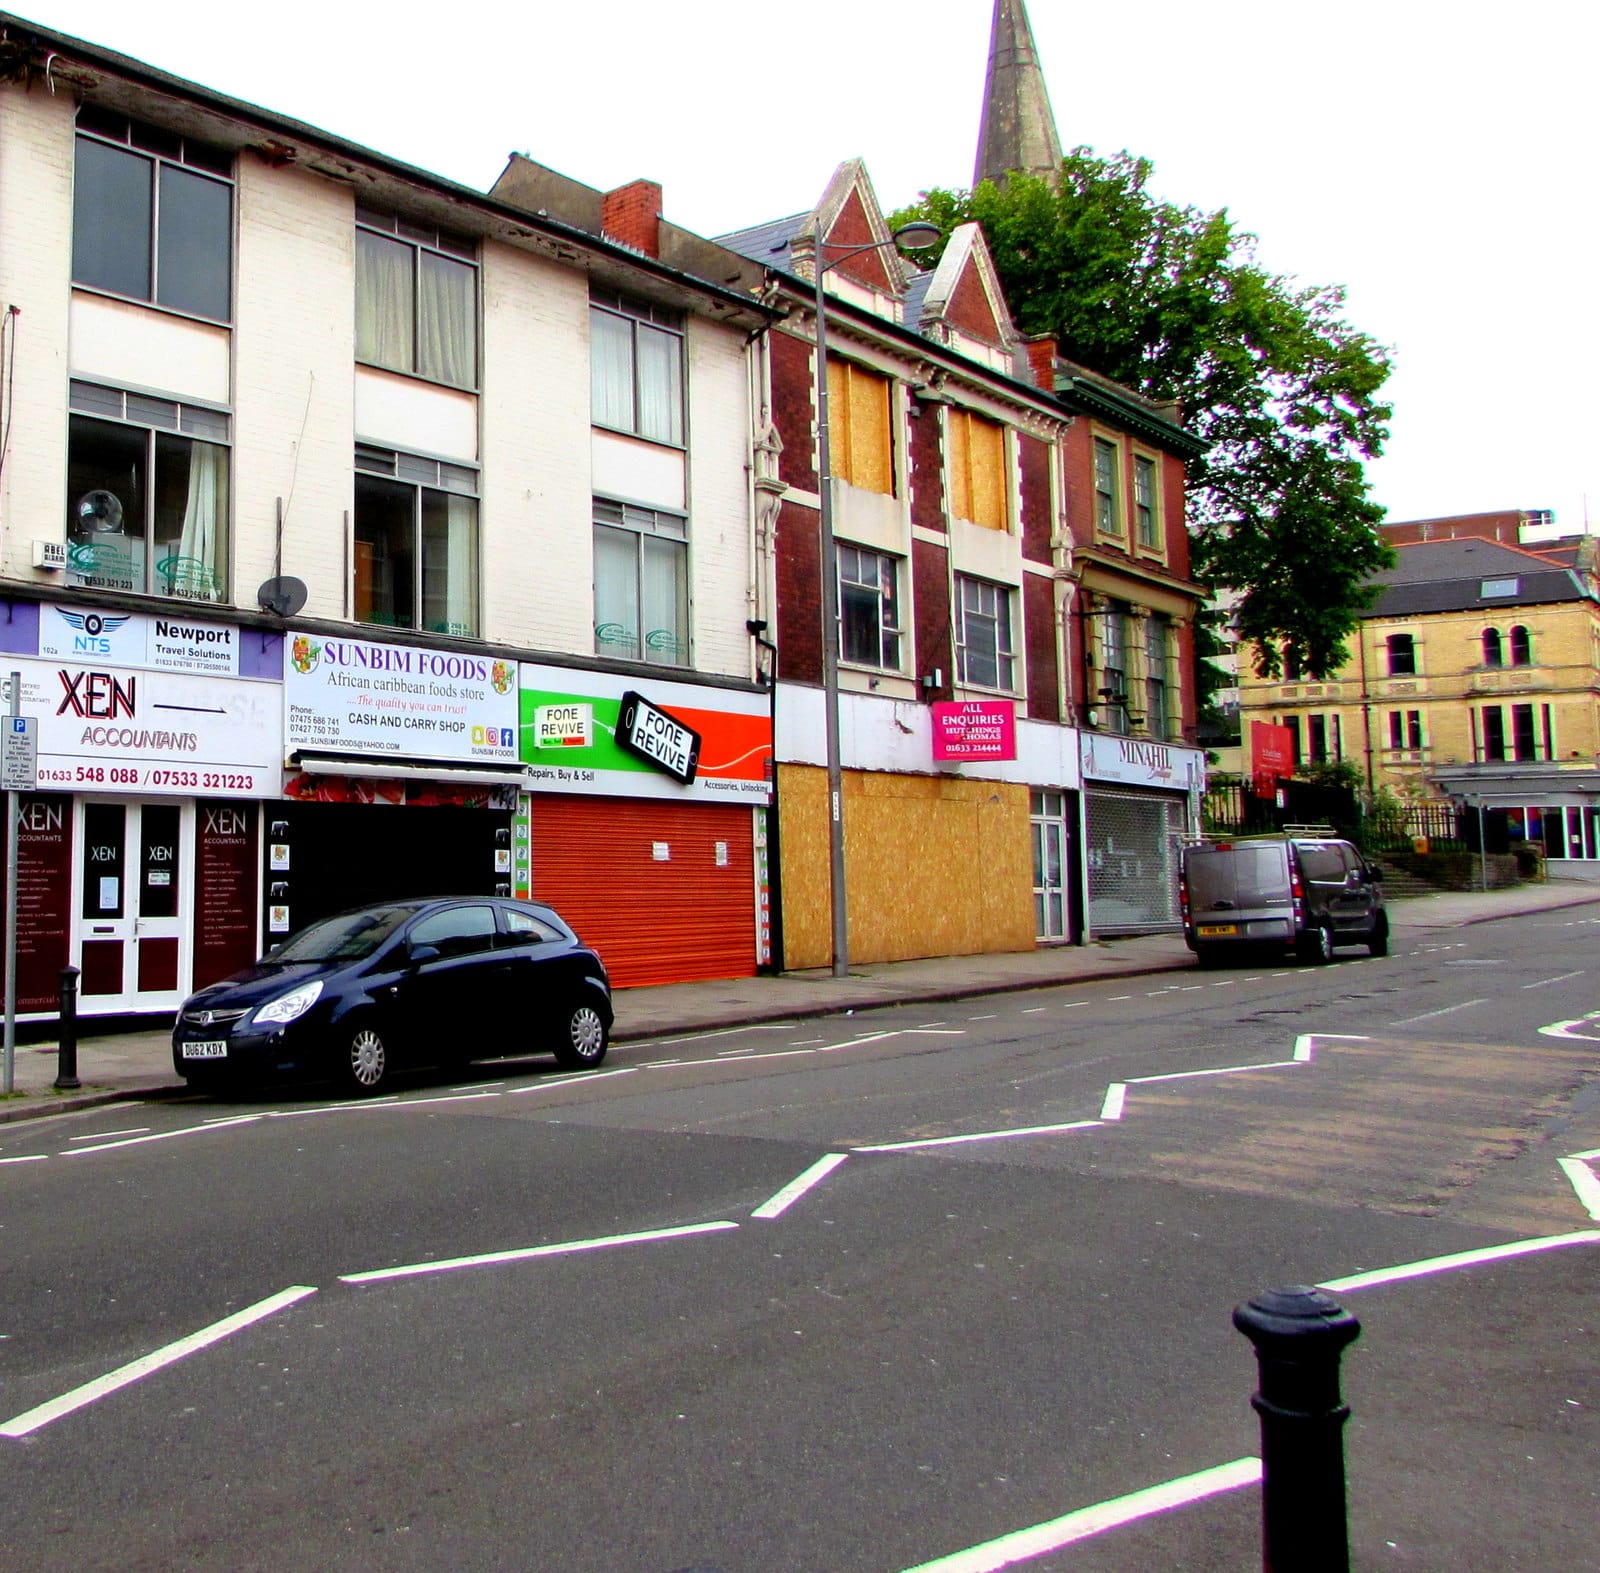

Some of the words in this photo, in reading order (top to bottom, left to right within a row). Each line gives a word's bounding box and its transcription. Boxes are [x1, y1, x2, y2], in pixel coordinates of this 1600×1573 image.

[44, 545, 64, 555] ABEL
[156, 621, 231, 644] Newport
[75, 635, 111, 653] NTS
[156, 644, 185, 656] Travel
[188, 647, 231, 660] Solutions
[324, 642, 411, 673] SUNBIM
[418, 653, 487, 682] FOODS
[327, 671, 370, 689] African
[373, 677, 426, 695] caribbean
[429, 681, 457, 698] foods
[460, 687, 485, 701] store
[56, 669, 136, 720] XEN
[290, 705, 314, 714] Phone:
[376, 697, 406, 712] quality
[409, 702, 425, 712] you
[427, 704, 442, 712] can
[962, 703, 983, 713] ALL
[290, 714, 312, 725] 07475
[327, 717, 340, 726] 741
[547, 708, 578, 721] FONE
[942, 714, 1004, 726] ENQUIRIES
[290, 724, 312, 734] 07427
[313, 725, 326, 735] 750
[348, 712, 378, 726] CASH
[380, 715, 402, 728] AND
[404, 717, 437, 731] CARRY
[439, 720, 466, 733] SHOP
[541, 722, 584, 736] REVIVE
[645, 710, 684, 748] FONE
[81, 726, 197, 752] ACCOUNTANTS
[471, 748, 494, 756] SUNBIM
[495, 750, 515, 758] FOODS
[635, 727, 686, 773] REVIVE
[945, 743, 970, 752] 01633
[972, 744, 1002, 752] 214444
[1119, 740, 1172, 770] MINAHIL
[38, 770, 72, 781] 01633
[76, 767, 105, 783] 548
[110, 768, 138, 784] 088
[202, 774, 253, 790] 321223
[528, 766, 556, 781] Repairs,
[558, 769, 572, 782] Buy
[573, 770, 580, 781] &
[581, 770, 595, 781] Sell
[740, 781, 769, 795] Unlocking
[17, 802, 62, 831] XEN
[204, 807, 246, 834] XEN
[16, 834, 63, 842] CCOUNTANTS
[91, 846, 116, 861] XEN
[149, 846, 173, 861] XEN
[185, 1044, 205, 1056] DU62
[206, 1042, 224, 1055] KDX
